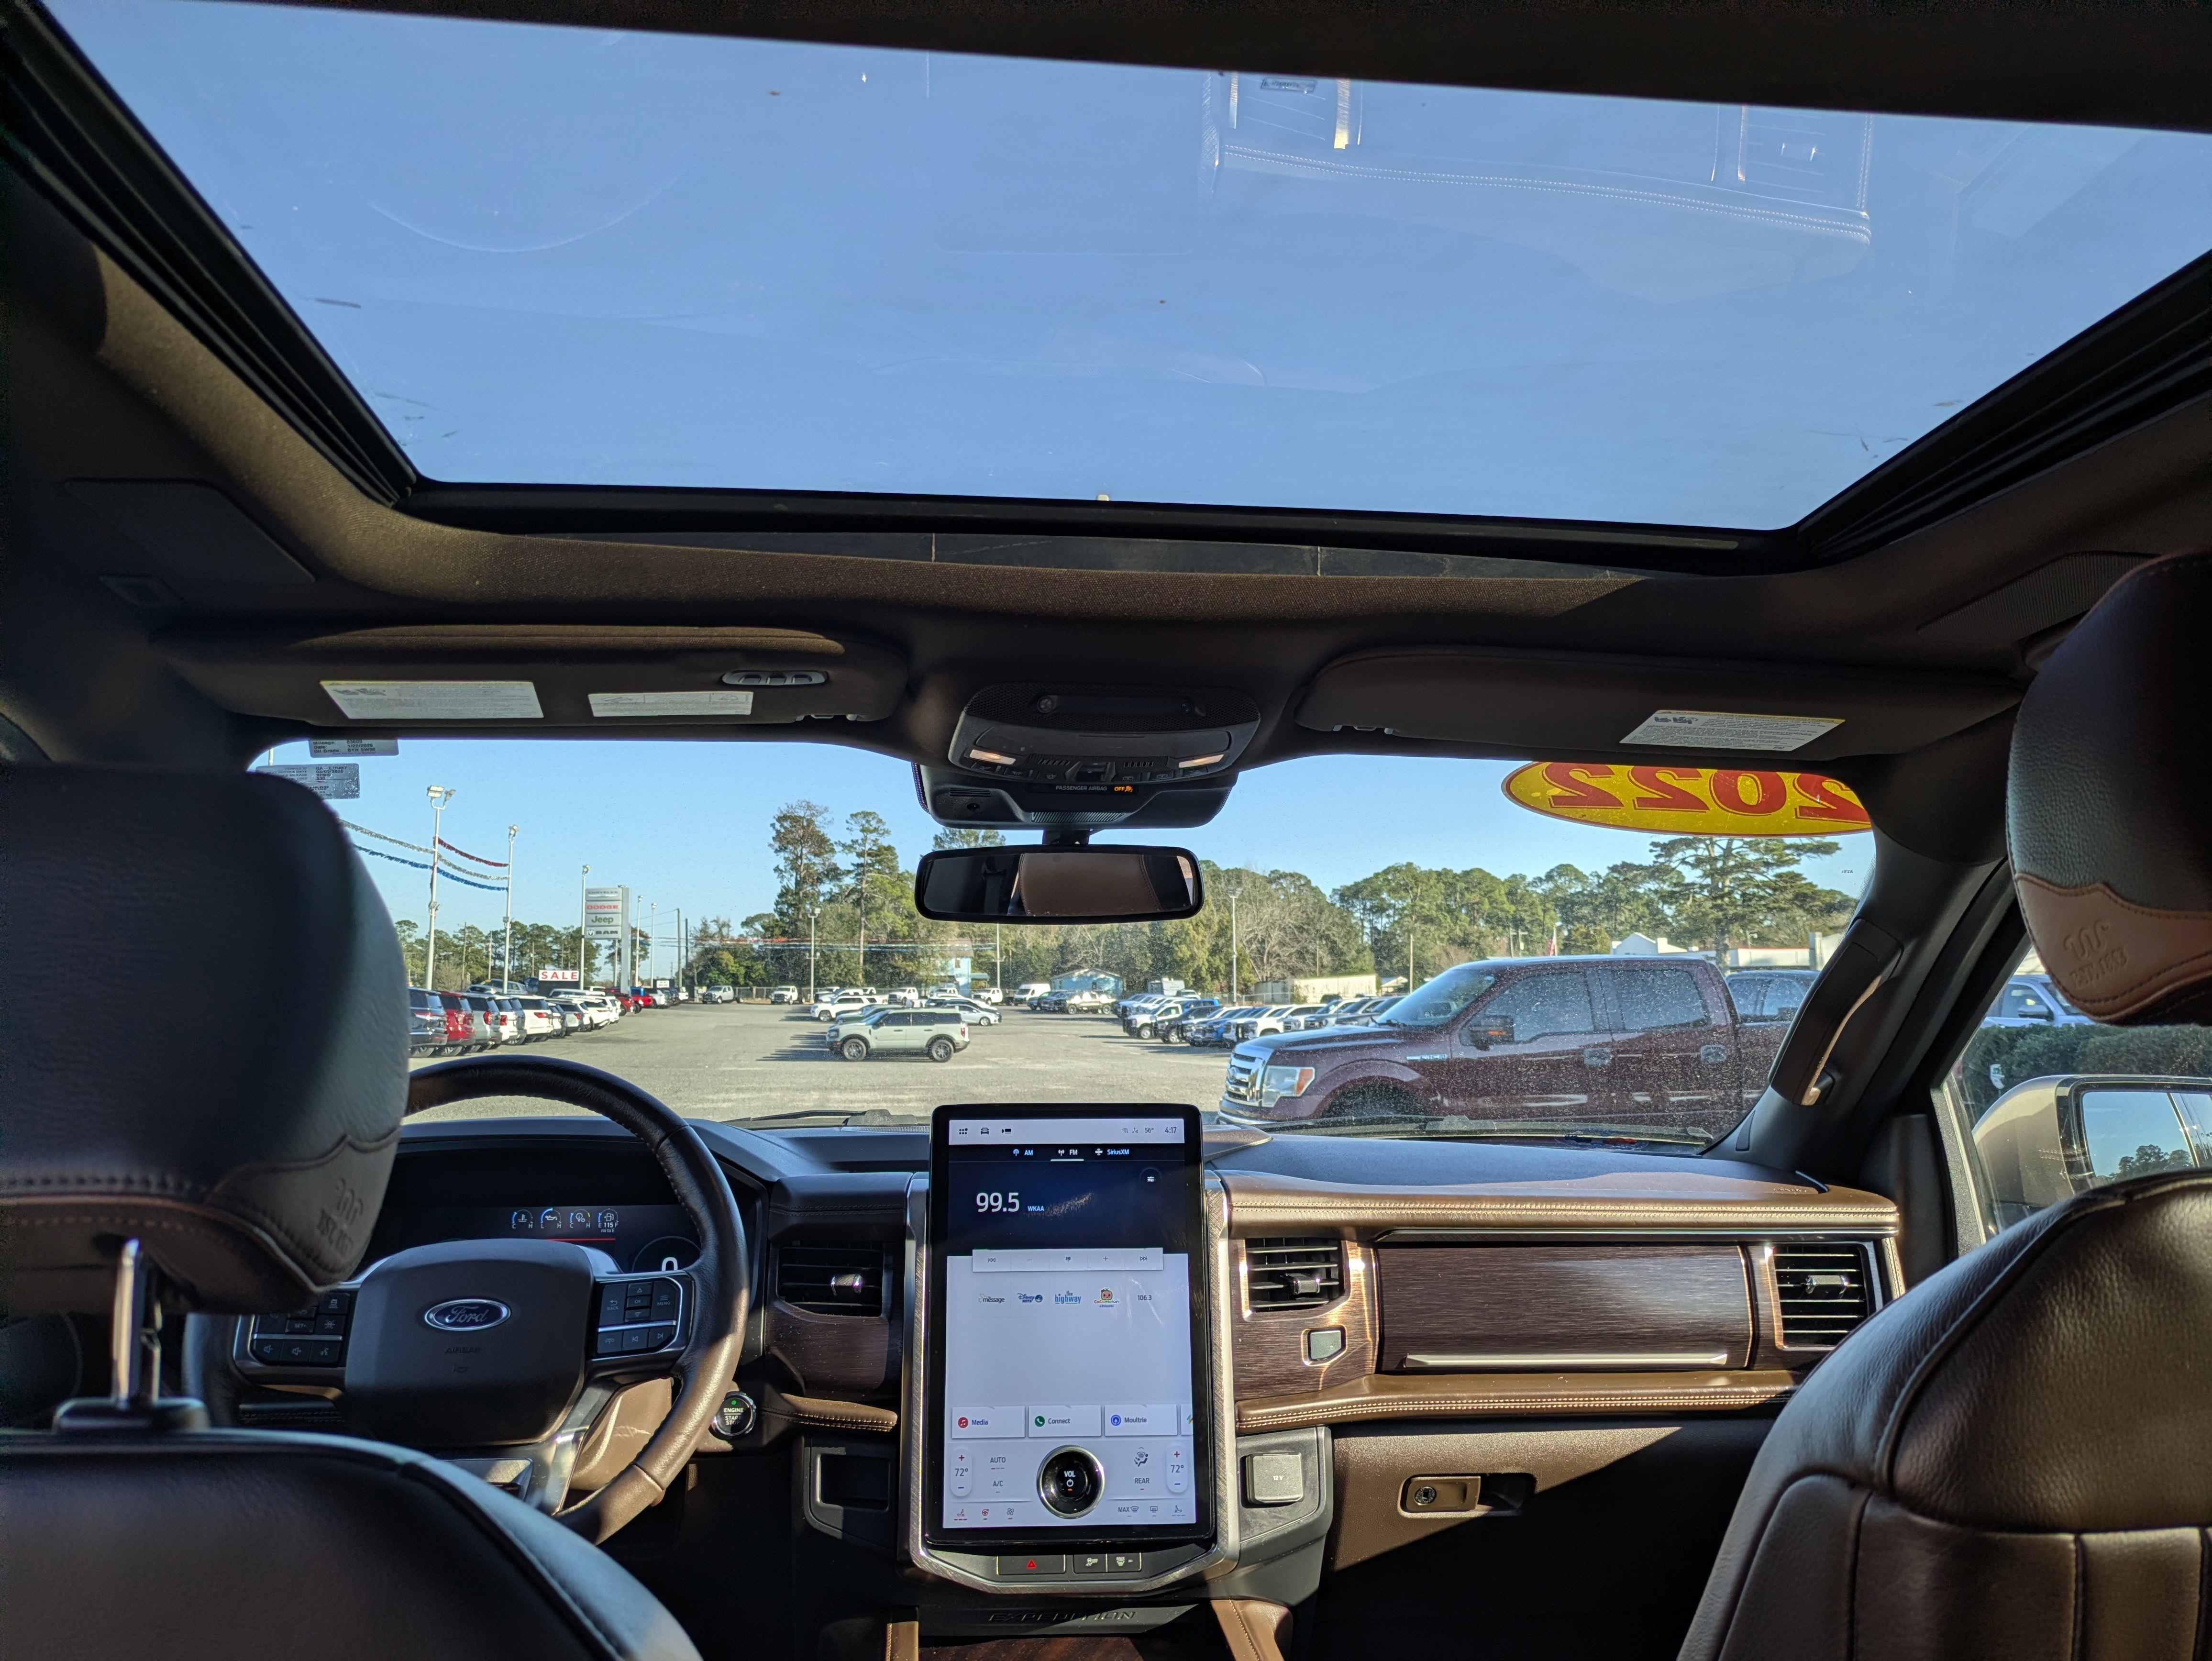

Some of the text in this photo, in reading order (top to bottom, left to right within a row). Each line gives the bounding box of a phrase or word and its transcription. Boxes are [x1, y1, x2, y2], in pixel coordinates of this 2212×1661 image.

[591, 915, 614, 925] Jeep
[541, 971, 578, 980] SALE
[976, 1192, 1020, 1213] 99.5
[1055, 1295, 1082, 1304] highway
[445, 1306, 489, 1323] Ford
[954, 1468, 969, 1477] 72°
[1170, 1464, 1184, 1473] 72°
[988, 1611, 1136, 1622] EXPEDITION
